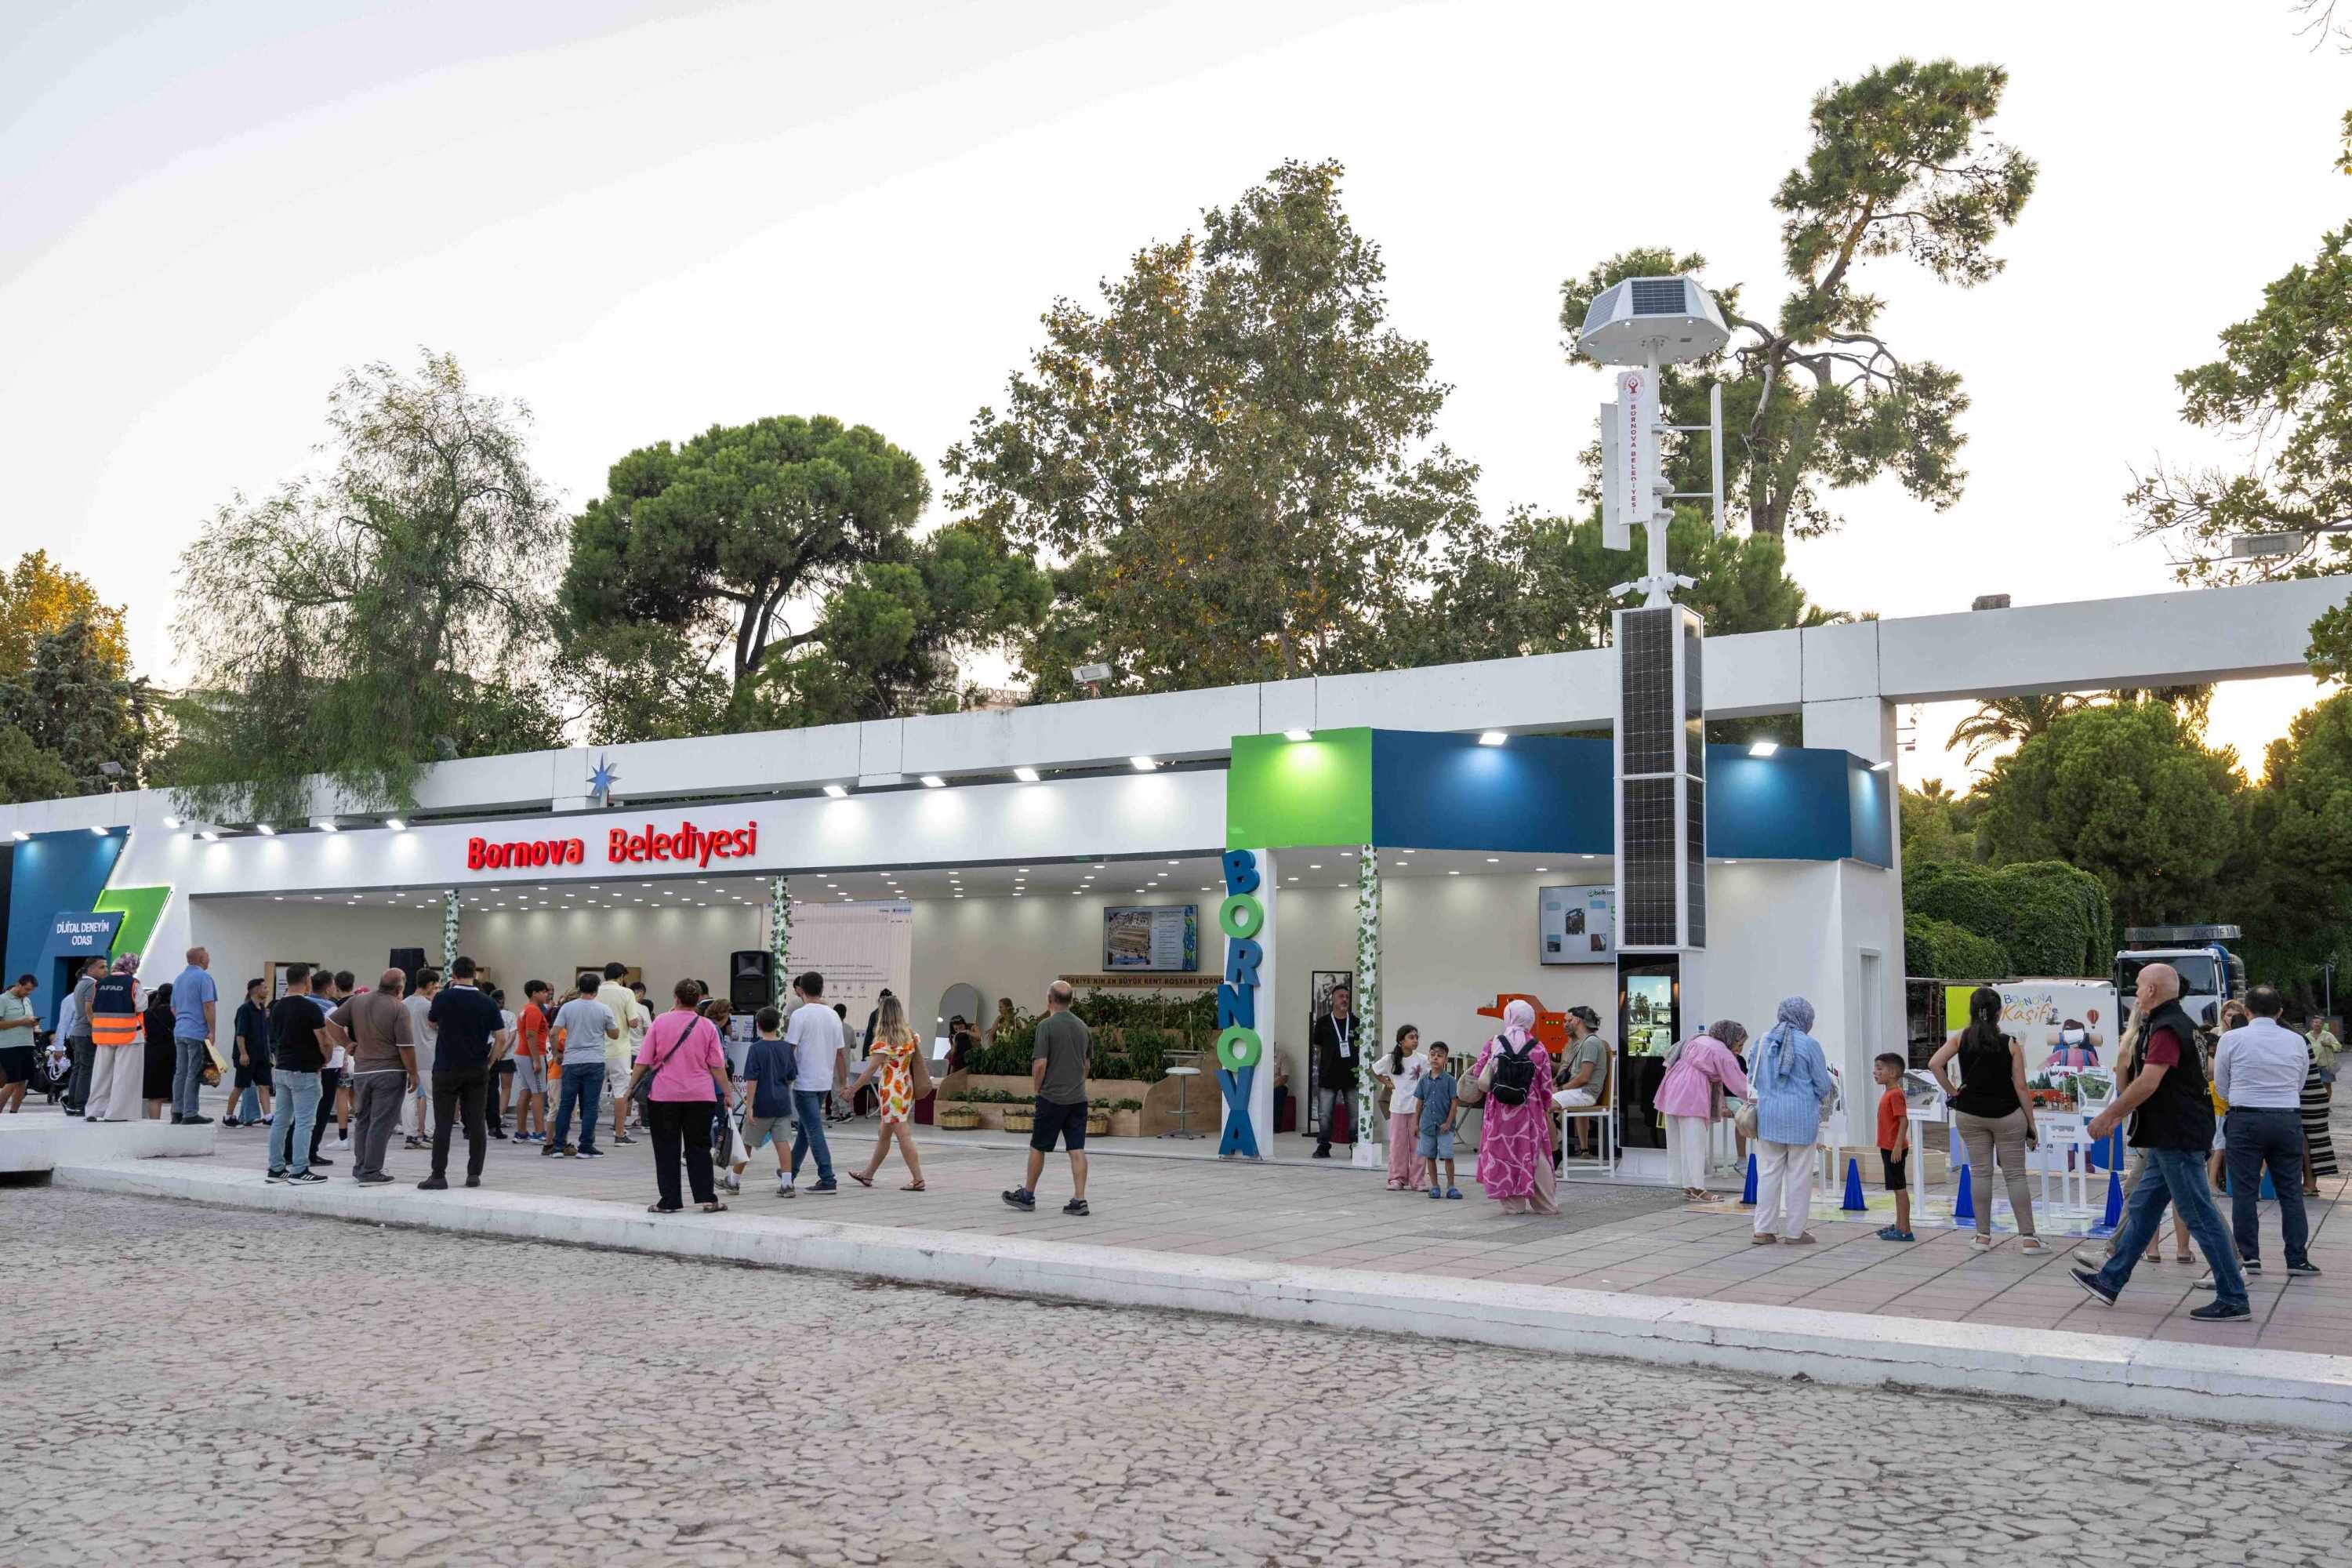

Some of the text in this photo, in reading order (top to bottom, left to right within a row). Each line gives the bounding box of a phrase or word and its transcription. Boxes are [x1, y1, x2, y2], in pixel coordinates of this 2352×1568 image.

[467, 821, 757, 870] Bornova Belediyesi
[56, 919, 109, 934] DİJİTAL DENEYİM
[71, 935, 93, 946] ODASI
[1216, 849, 1264, 1155] BORNOVA
